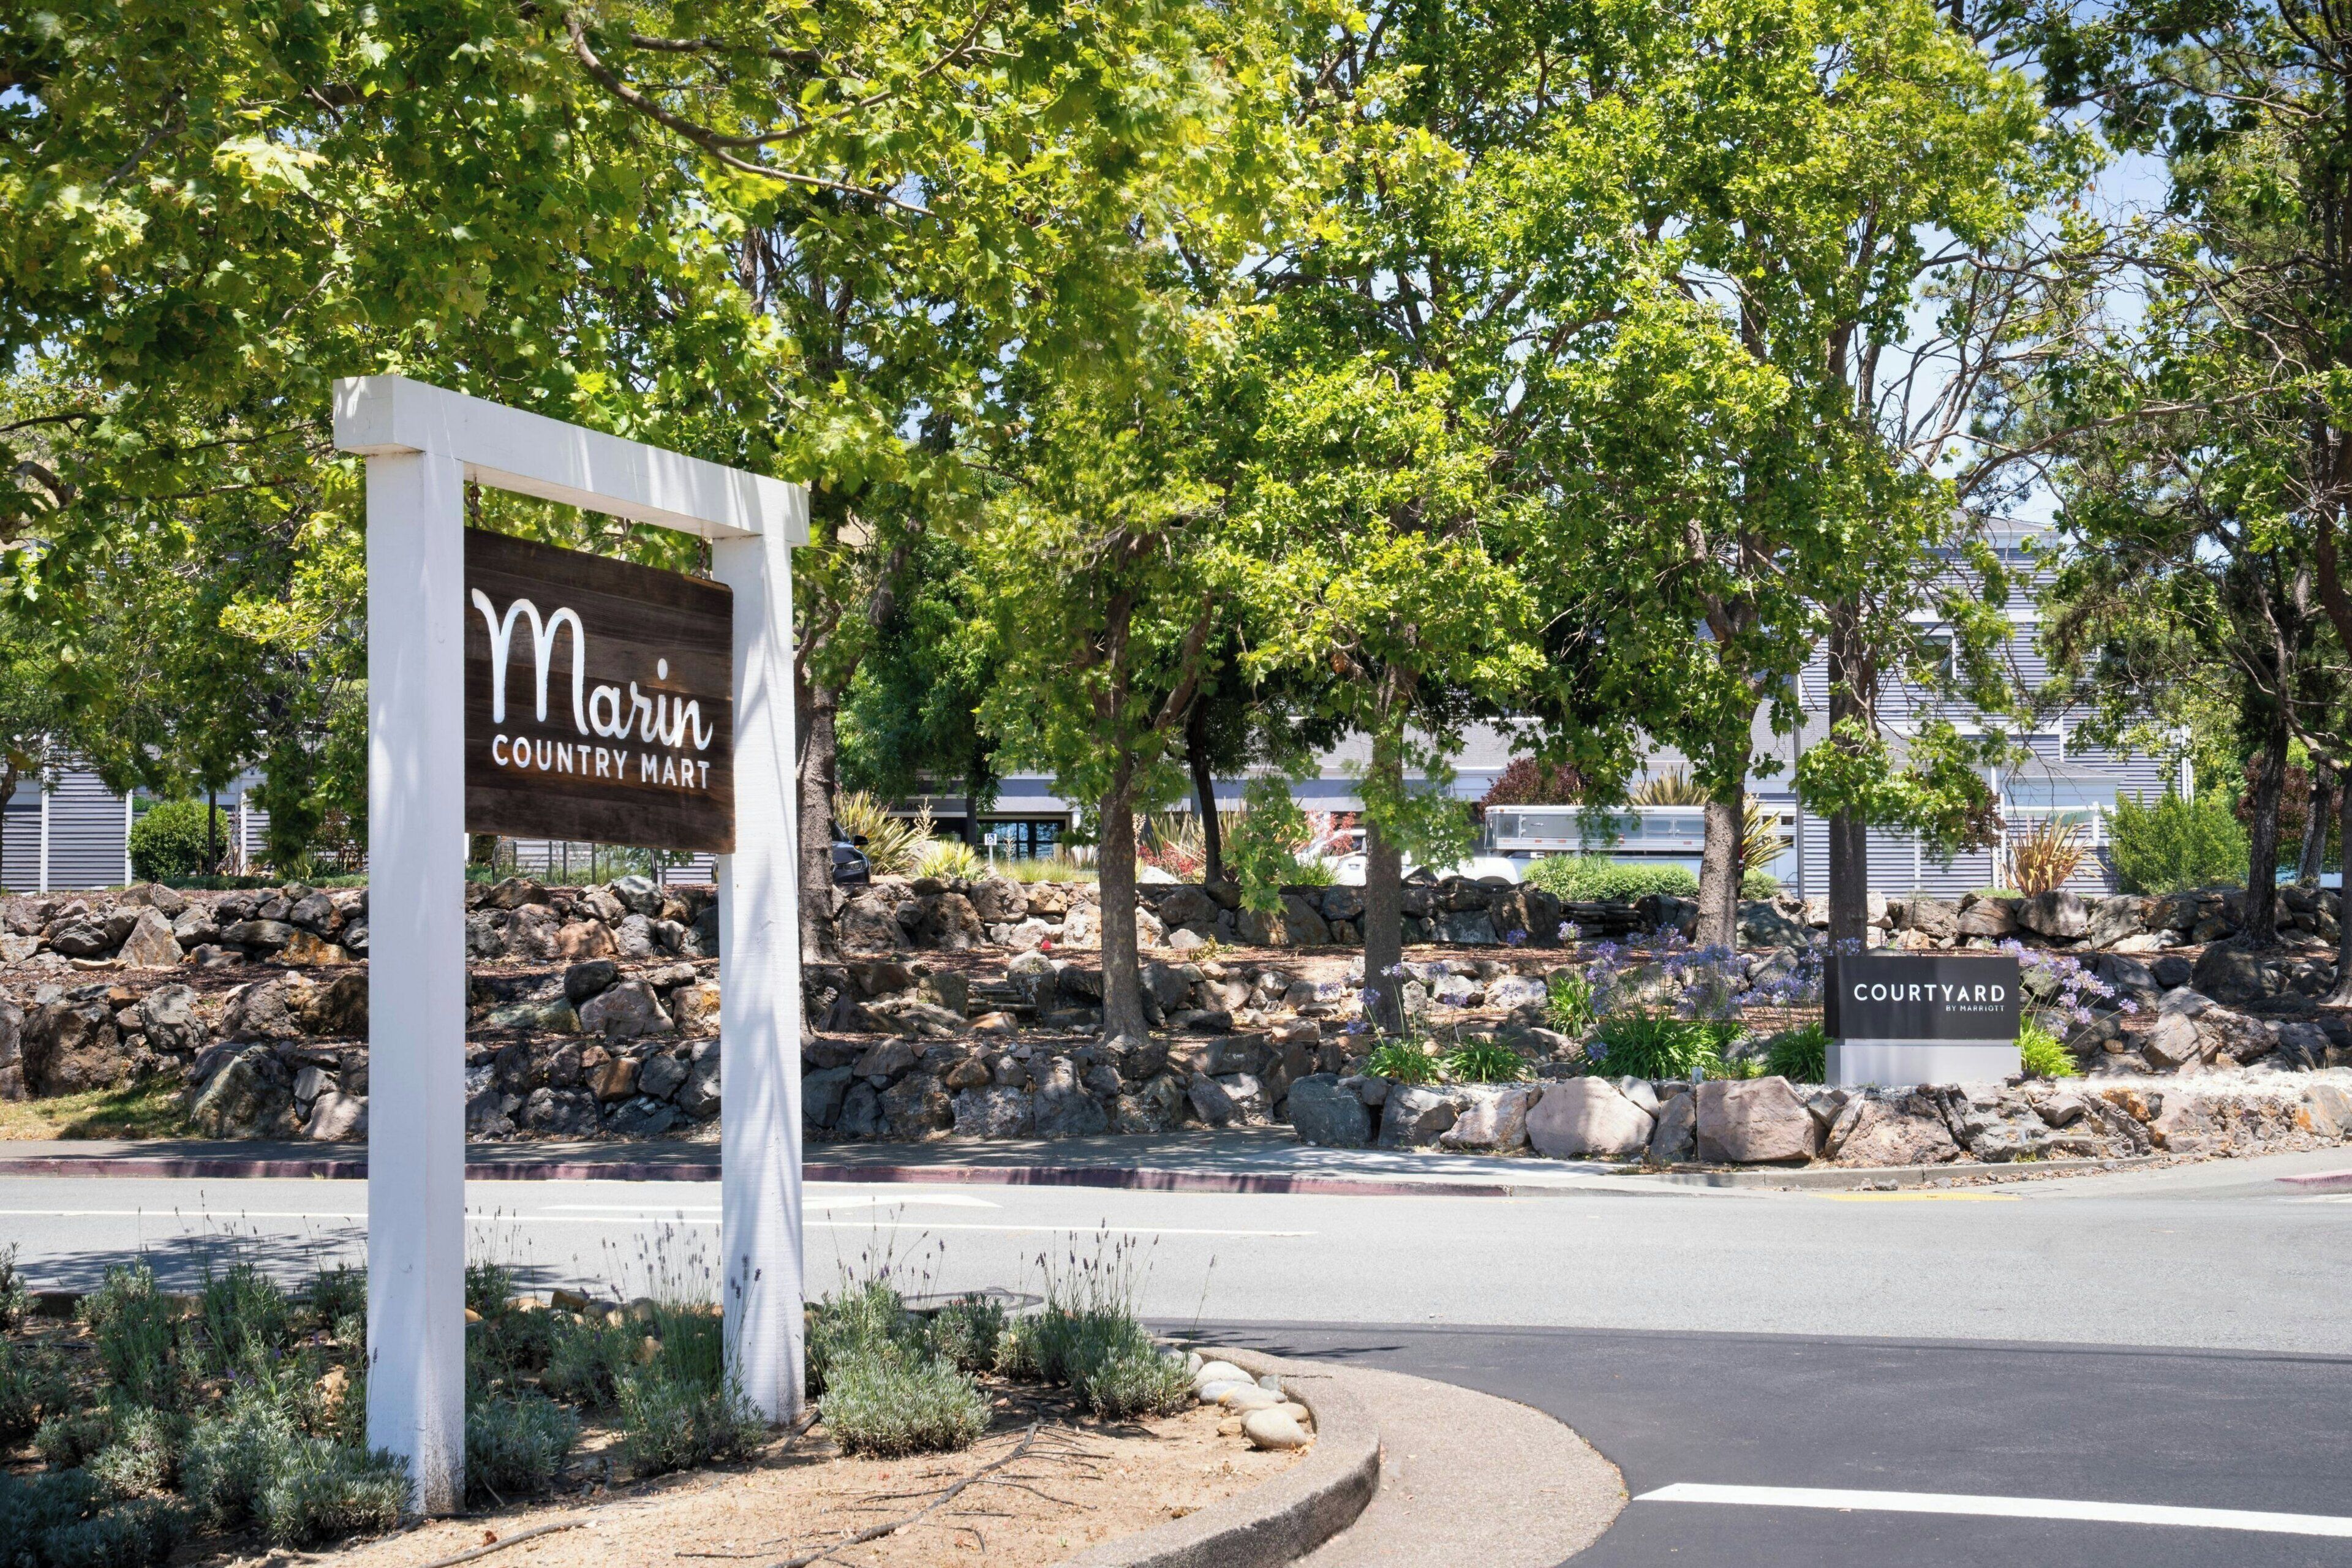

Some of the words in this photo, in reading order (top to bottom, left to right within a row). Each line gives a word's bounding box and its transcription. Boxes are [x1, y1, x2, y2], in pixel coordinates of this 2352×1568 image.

[471, 587, 714, 751] Marin
[492, 734, 628, 779] COUNTRY
[641, 753, 710, 789] MART
[1853, 983, 2005, 1002] COURTYARD
